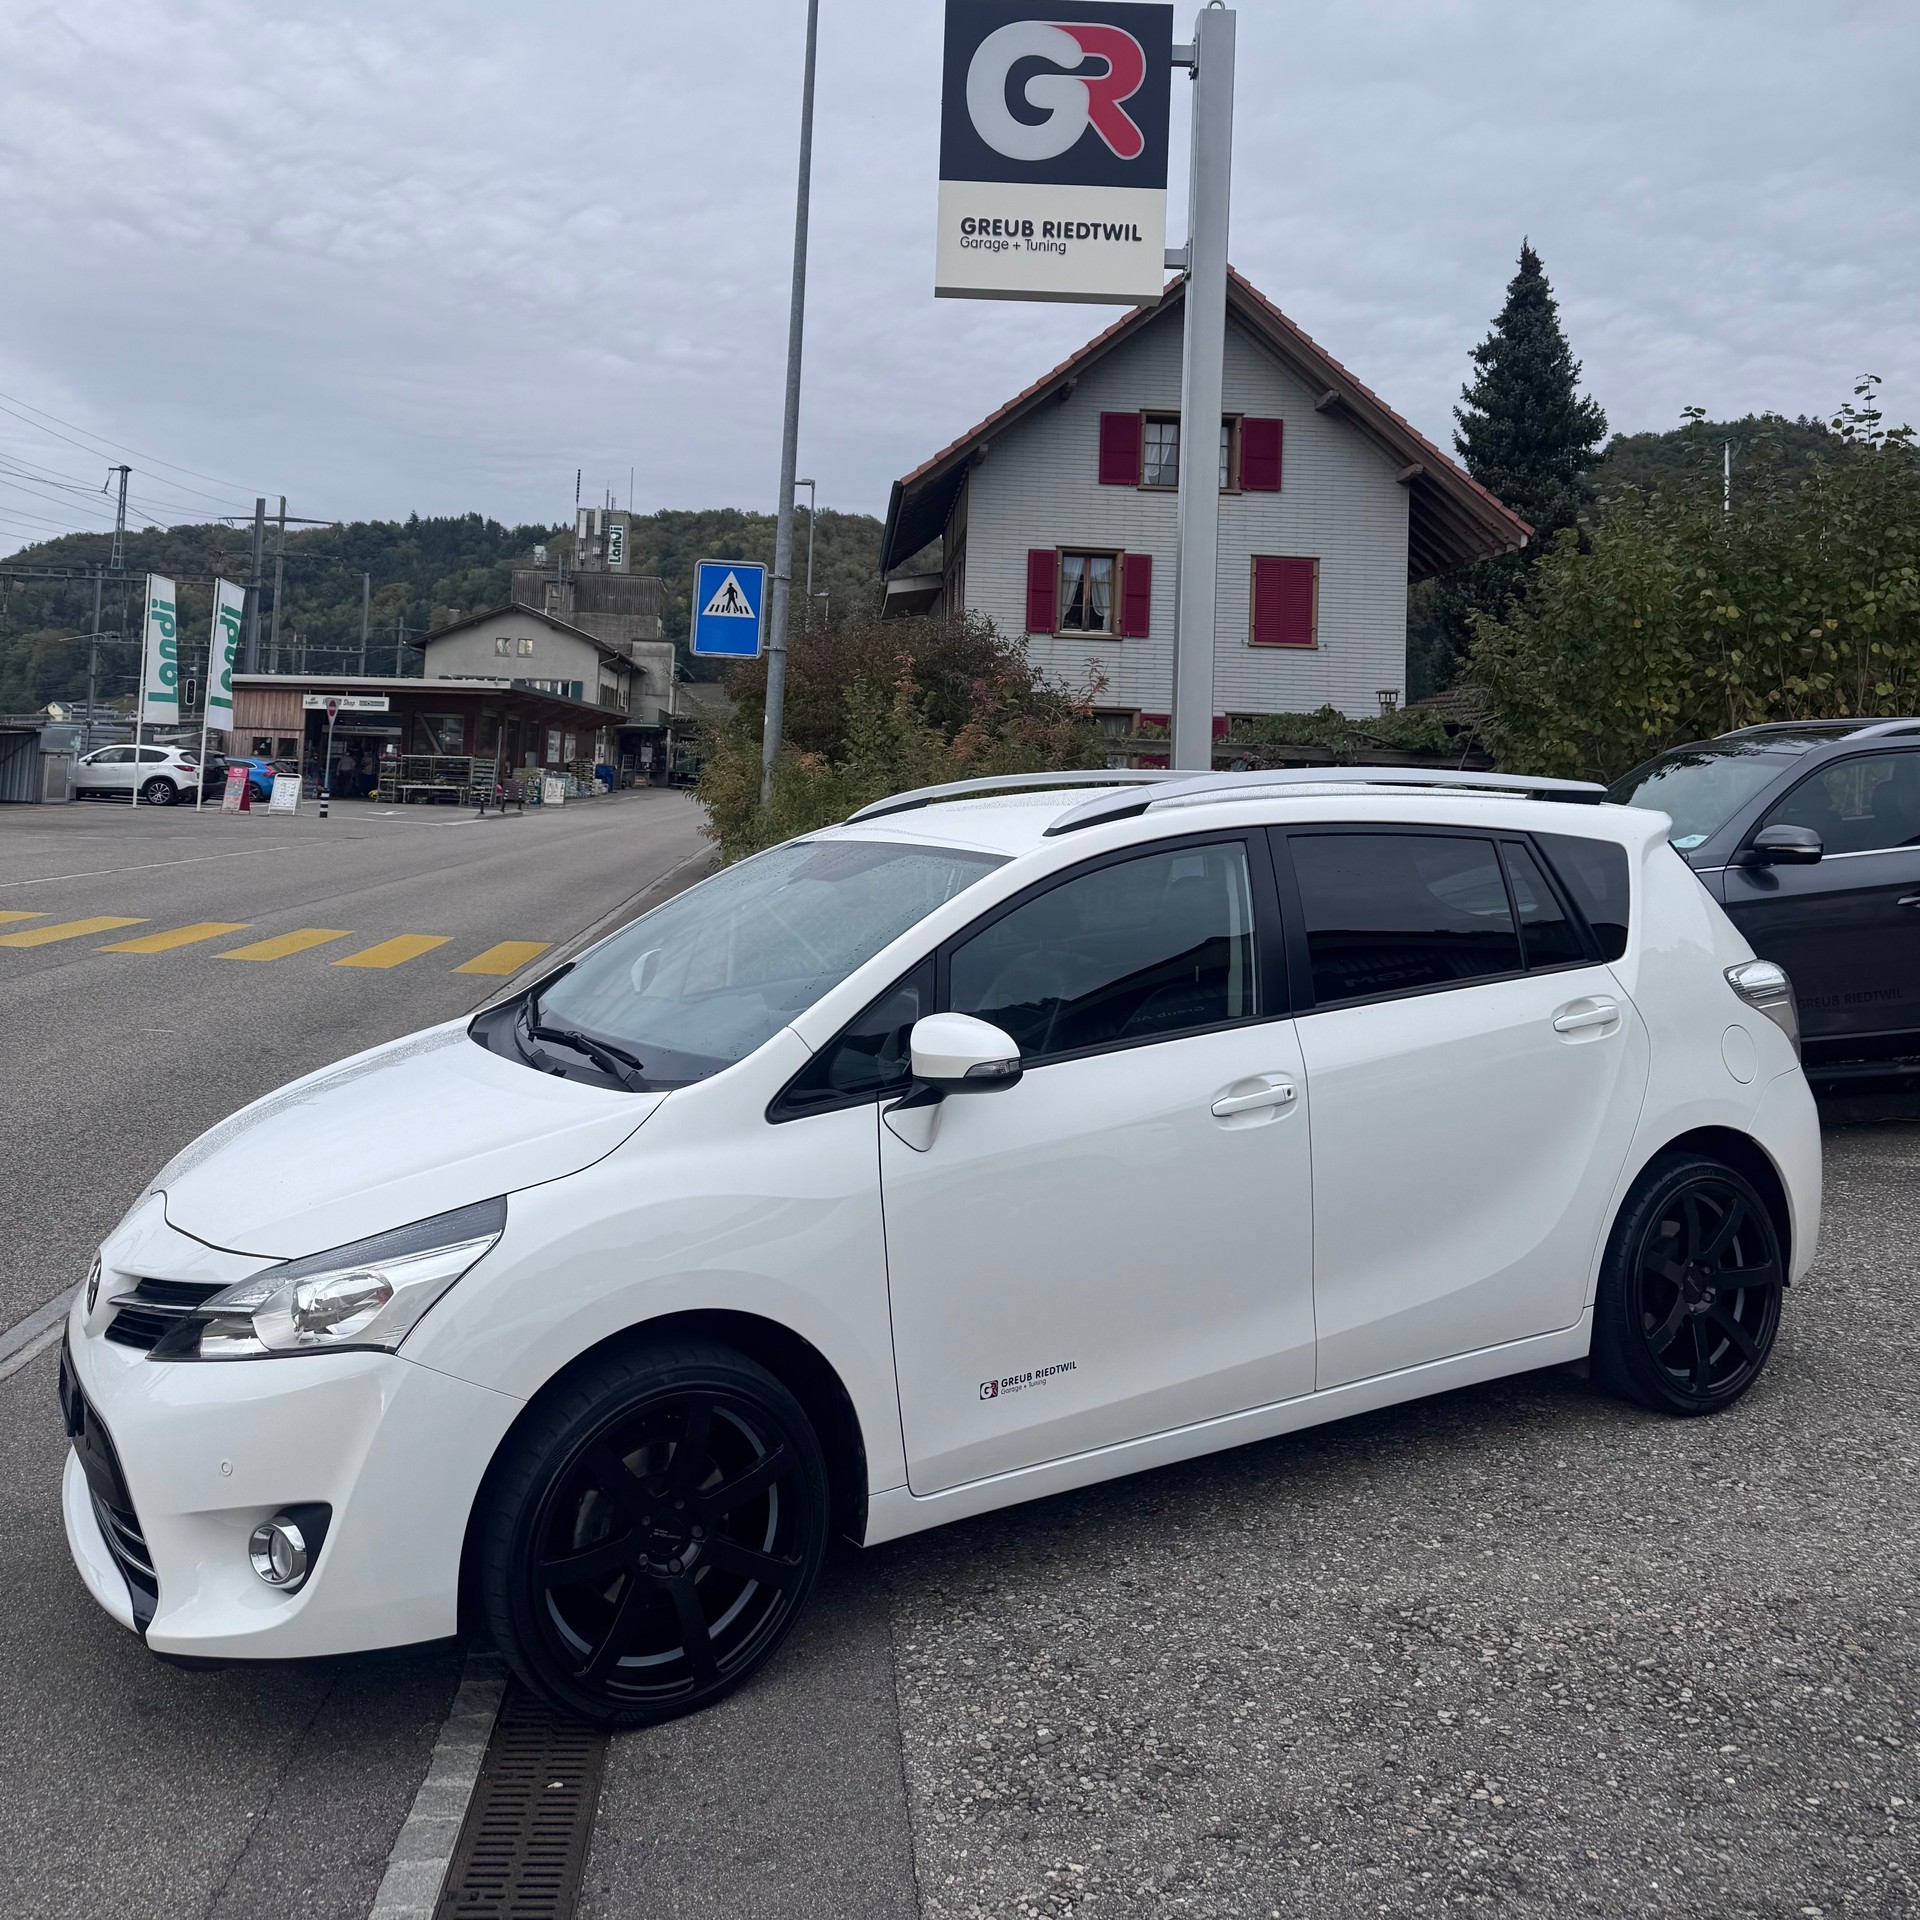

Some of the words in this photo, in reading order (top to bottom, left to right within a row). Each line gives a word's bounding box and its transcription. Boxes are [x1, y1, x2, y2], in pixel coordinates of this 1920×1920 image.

[966, 20, 1147, 161] GR
[960, 216, 1035, 237] GREUB
[1042, 220, 1143, 242] RIEDTWIL
[960, 235, 1009, 253] Garage
[1012, 239, 1021, 250] +
[1024, 238, 1067, 256] Tuning
[147, 598, 179, 704] Landi
[1797, 995, 1840, 1010] GREUB
[1844, 988, 1904, 1005] RIEDTWIL
[1001, 1372, 1033, 1388] GREUB
[1035, 1361, 1077, 1379] RIEDTWIL
[980, 1380, 998, 1400] GR
[1001, 1384, 1022, 1395] Garage
[1028, 1379, 1047, 1390] Tuning
